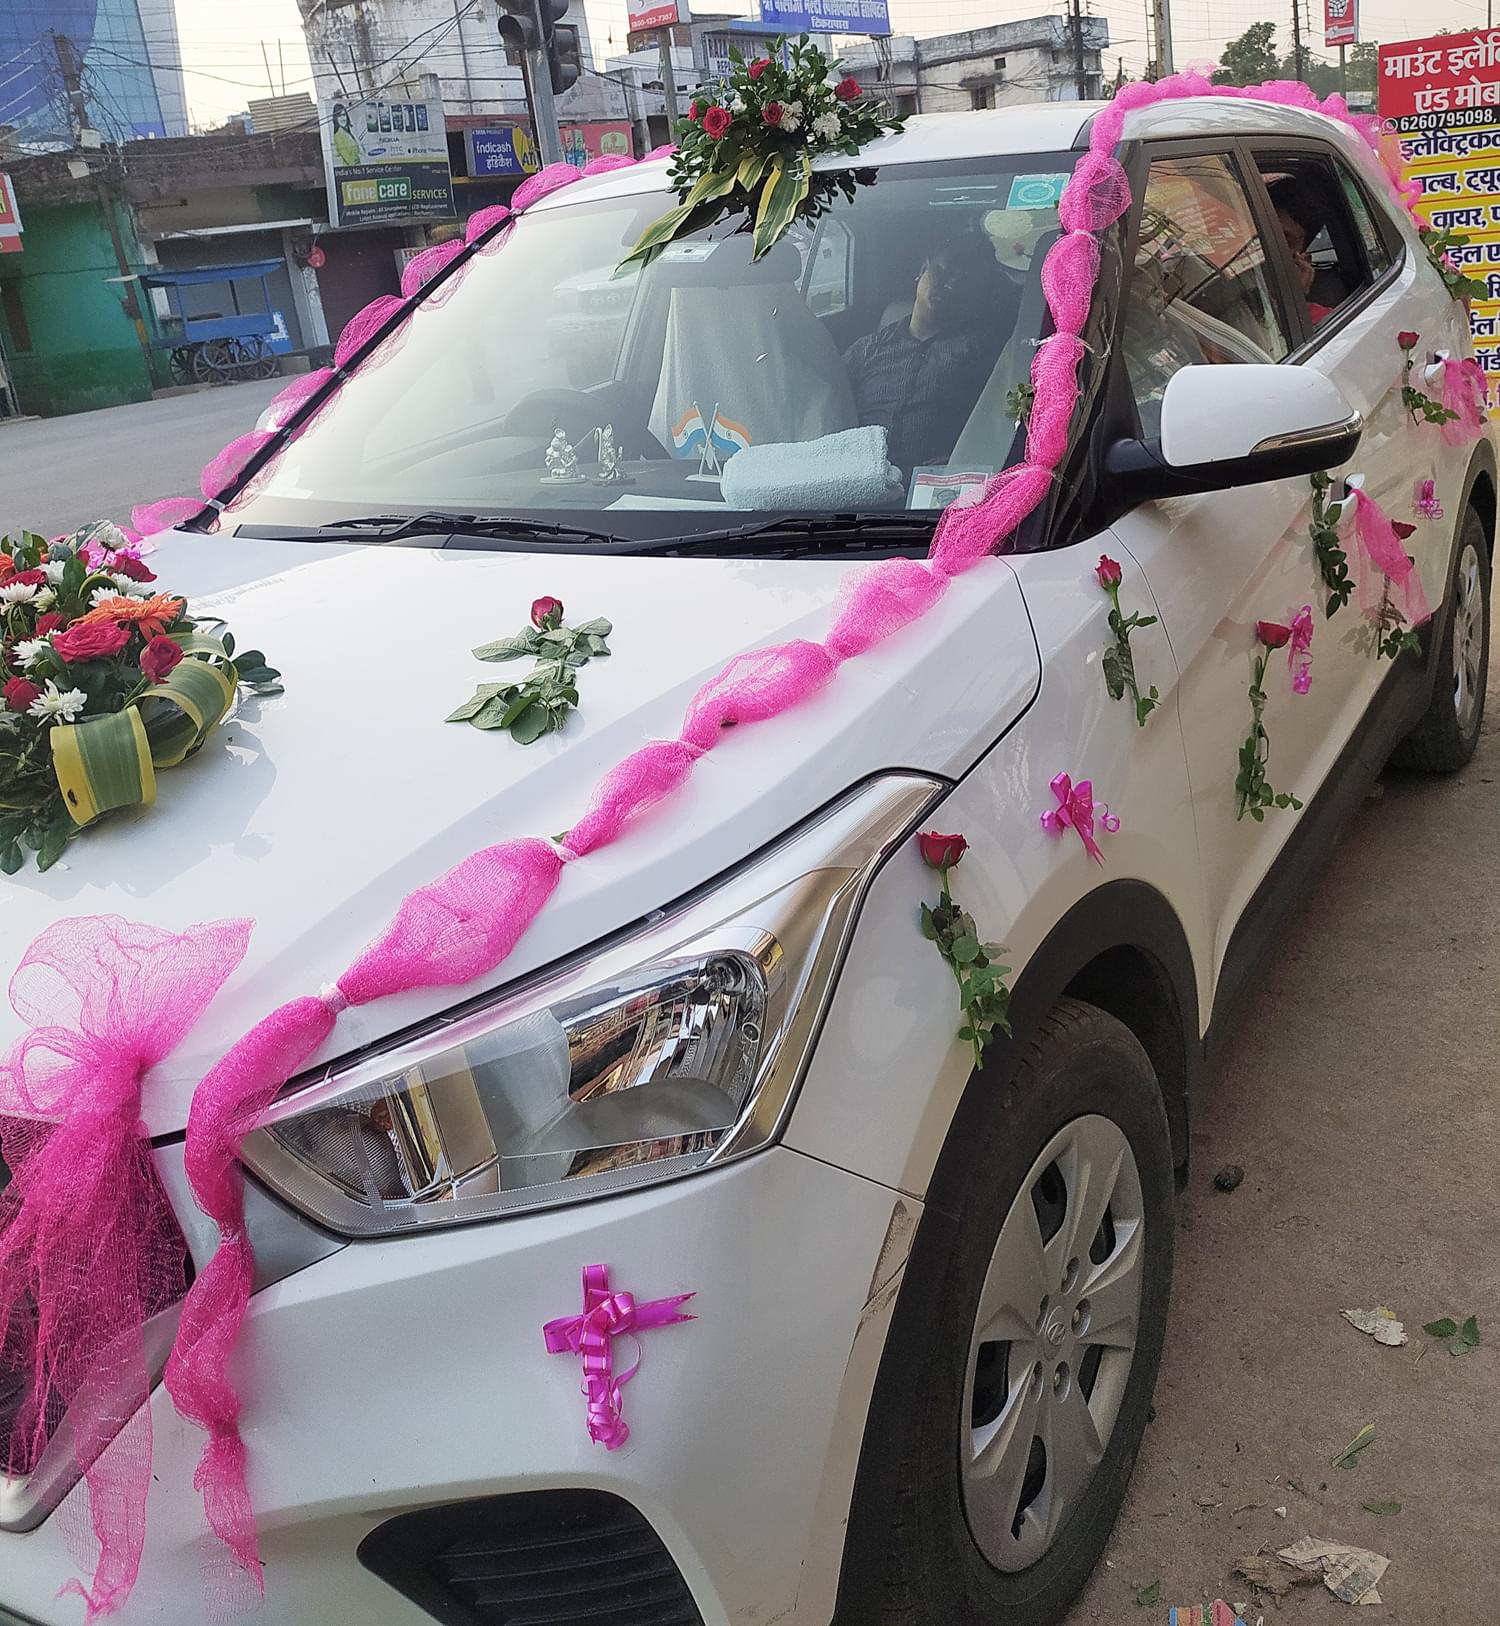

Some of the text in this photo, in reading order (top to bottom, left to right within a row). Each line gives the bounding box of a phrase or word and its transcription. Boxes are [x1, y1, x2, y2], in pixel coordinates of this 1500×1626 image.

[1384, 47, 1443, 79] माउंट
[1413, 75, 1500, 114] एंड मोब
[1400, 109, 1497, 131] 6260795098,
[476, 141, 512, 153] indicash
[1465, 168, 1500, 192] ट्यू
[346, 182, 407, 201] fone care
[412, 188, 448, 200] SERVICES
[1432, 208, 1487, 229] वायर,
